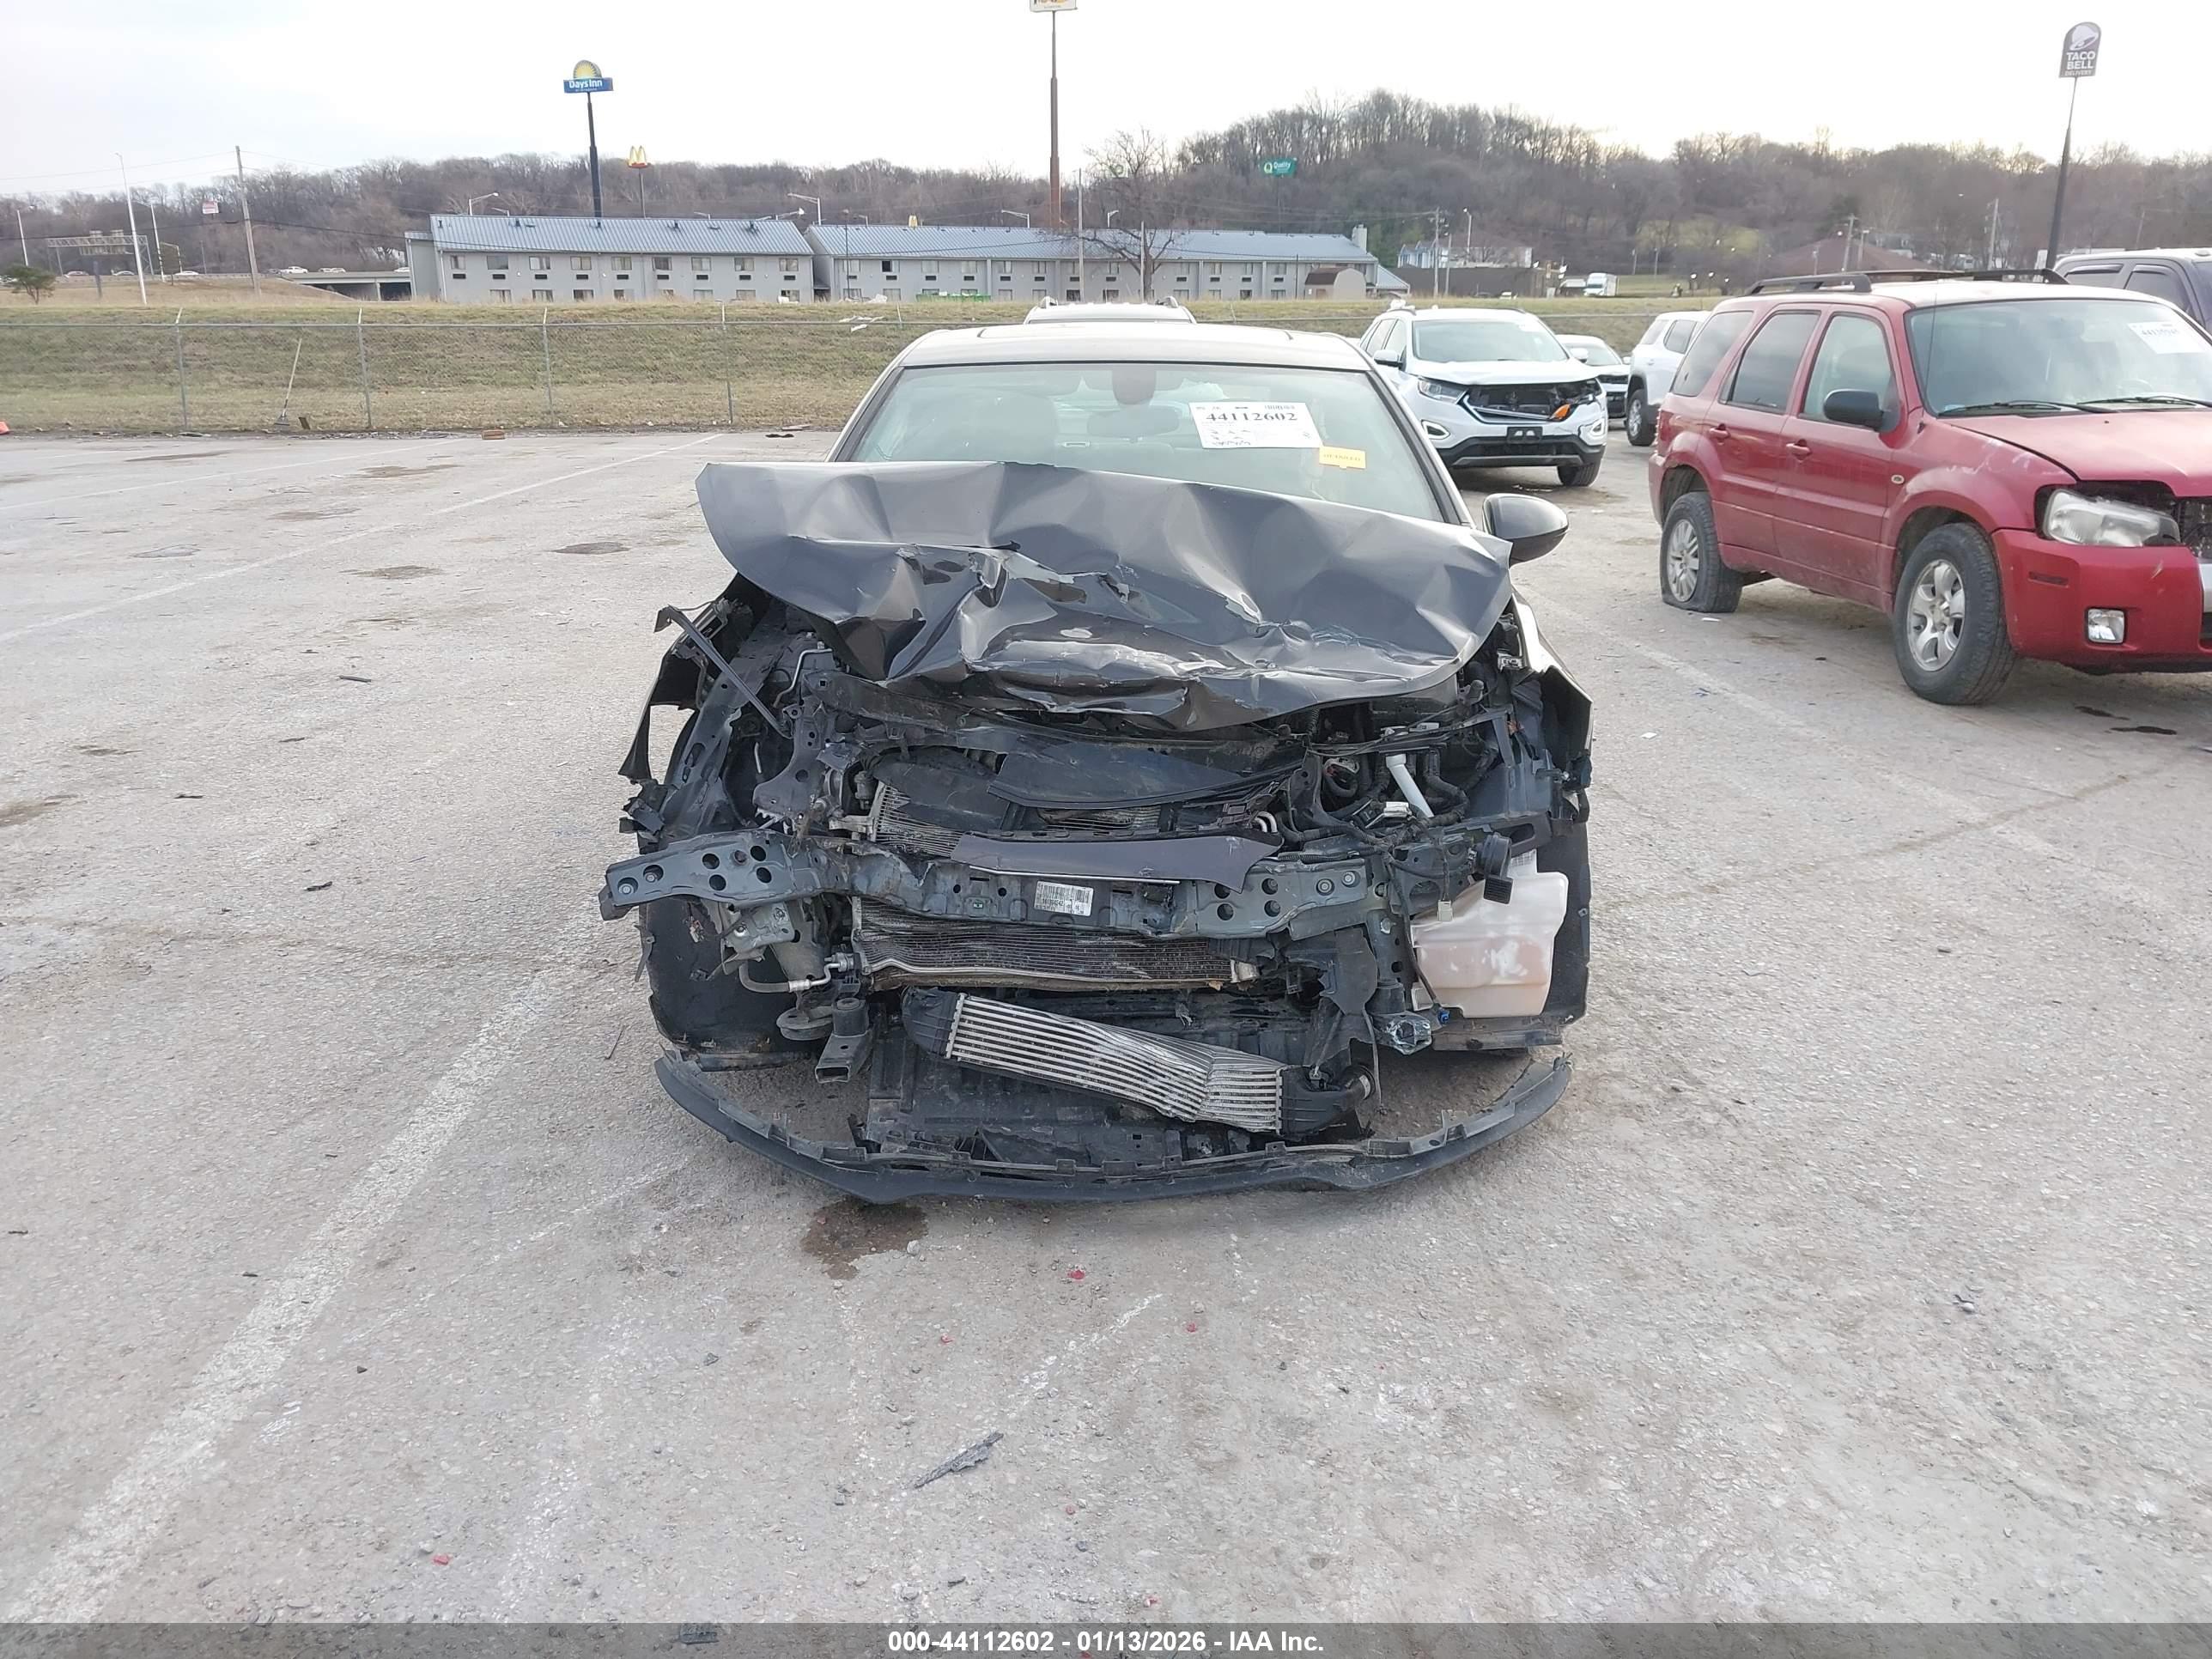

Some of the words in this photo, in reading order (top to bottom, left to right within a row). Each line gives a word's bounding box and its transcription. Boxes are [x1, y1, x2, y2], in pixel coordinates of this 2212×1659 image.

[2066, 51, 2096, 61] TACO
[2067, 59, 2094, 70] BELL
[568, 80, 589, 89] Days
[589, 79, 603, 88] Inn
[1206, 412, 1298, 422] 44112602
